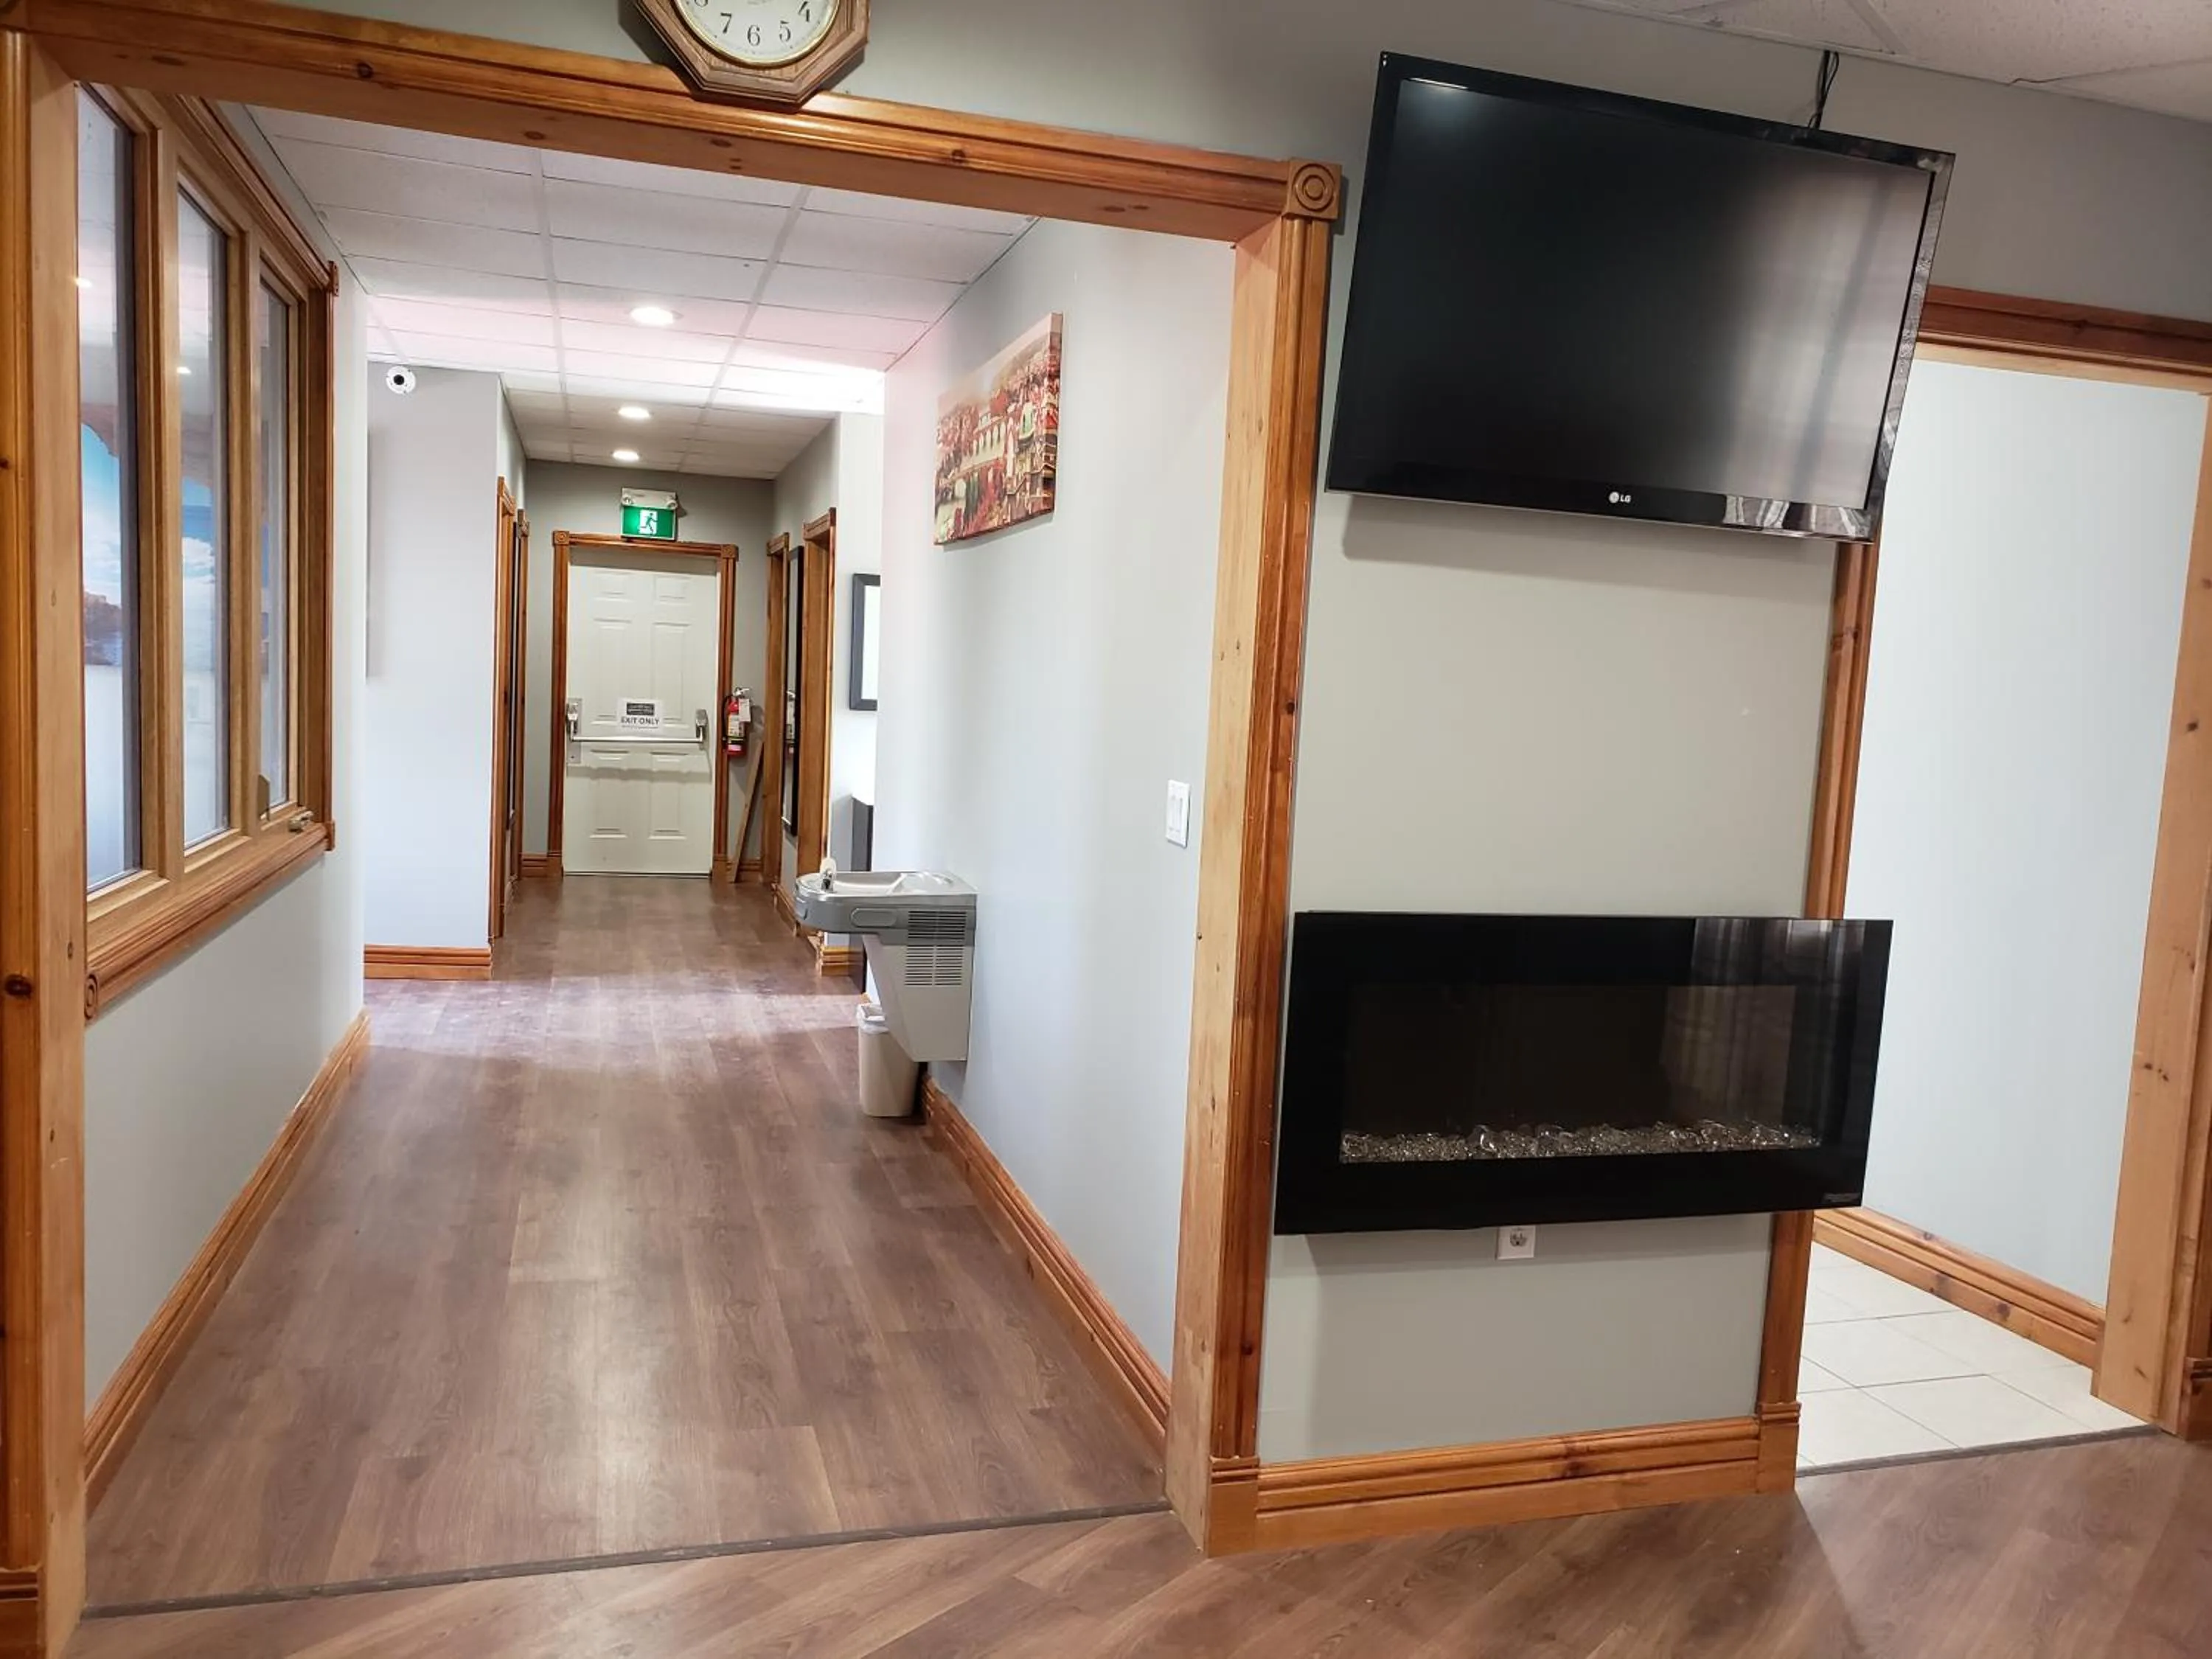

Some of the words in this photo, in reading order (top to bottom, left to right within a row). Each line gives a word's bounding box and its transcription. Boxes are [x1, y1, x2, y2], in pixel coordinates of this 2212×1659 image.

[798, 1, 810, 22] 4
[720, 12, 732, 34] 7
[779, 20, 791, 42] 5
[747, 24, 760, 46] 6
[1620, 495, 1632, 504] LG
[621, 716, 637, 724] EXIT
[639, 717, 659, 726] ONLY
